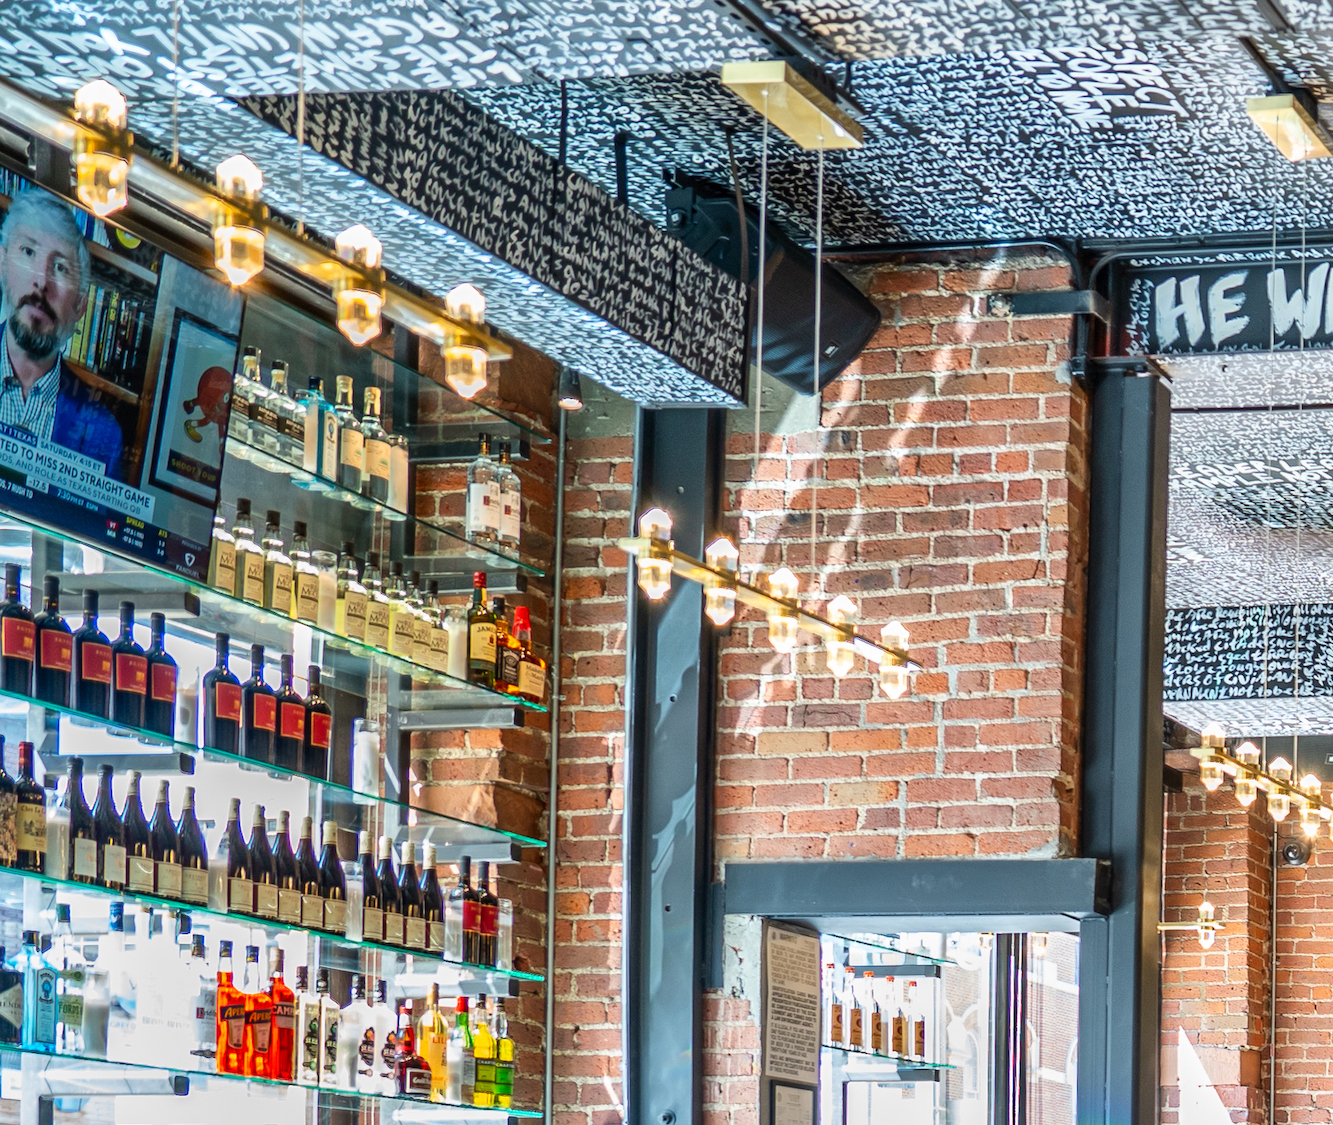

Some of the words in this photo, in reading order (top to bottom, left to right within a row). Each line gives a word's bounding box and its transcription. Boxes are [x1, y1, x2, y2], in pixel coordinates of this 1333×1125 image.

[1155, 270, 1251, 350] HE
[21, 446, 34, 461] TO
[35, 451, 59, 471] MISS
[60, 462, 78, 480] 2ND
[80, 471, 124, 498] STRAIGHT
[125, 489, 151, 509] GAME
[35, 465, 56, 480] ROLE
[69, 481, 93, 498] TEXAS
[93, 490, 129, 512] STARTING
